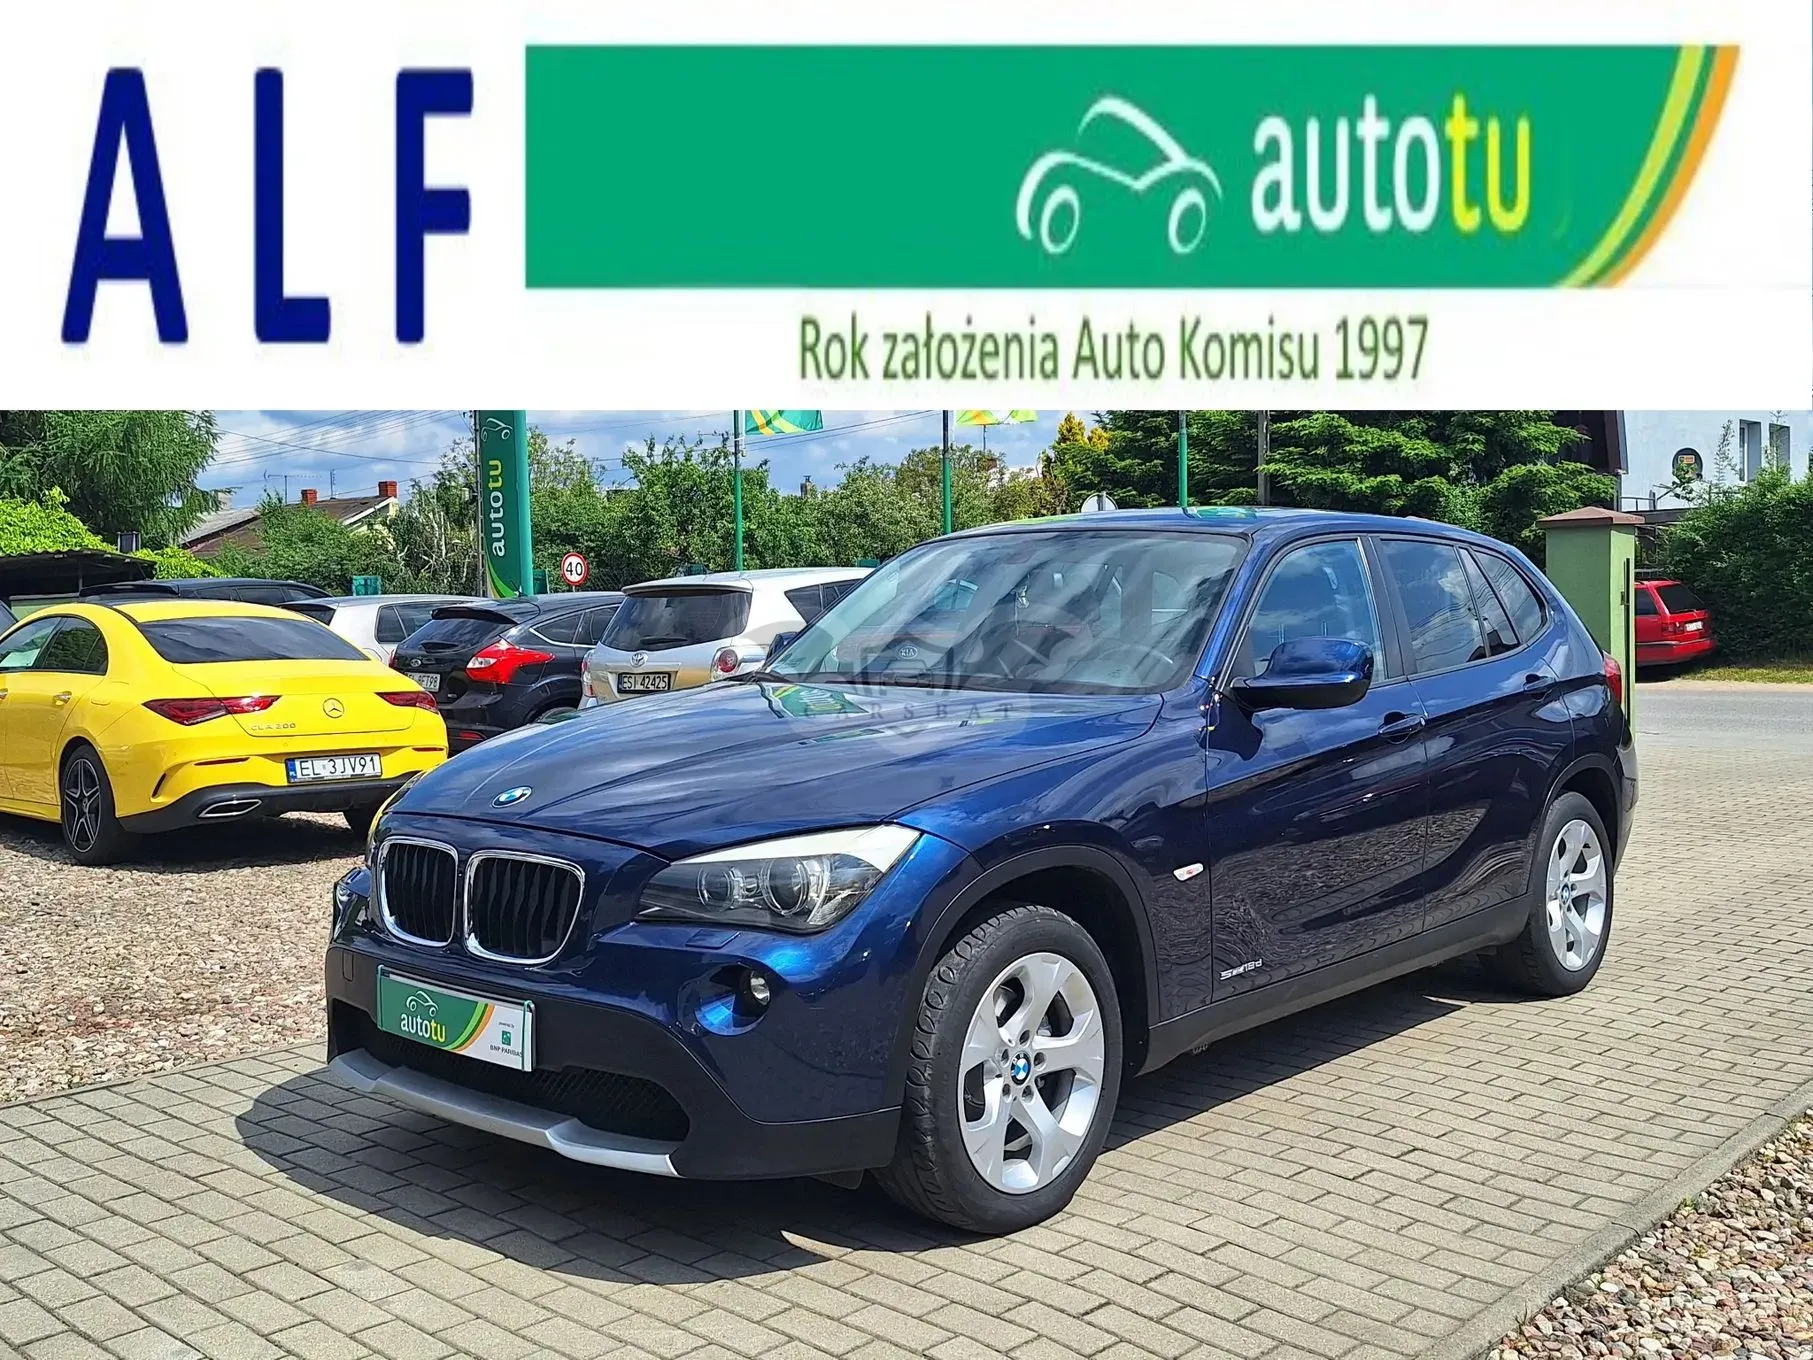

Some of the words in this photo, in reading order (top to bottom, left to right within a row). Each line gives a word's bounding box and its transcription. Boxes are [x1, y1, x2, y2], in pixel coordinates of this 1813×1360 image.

[488, 459, 505, 557] autotu
[565, 561, 584, 577] 40
[640, 675, 667, 689] 42425
[299, 760, 321, 777] EL
[327, 756, 376, 775] 3JV91
[400, 1013, 446, 1043] autotu
